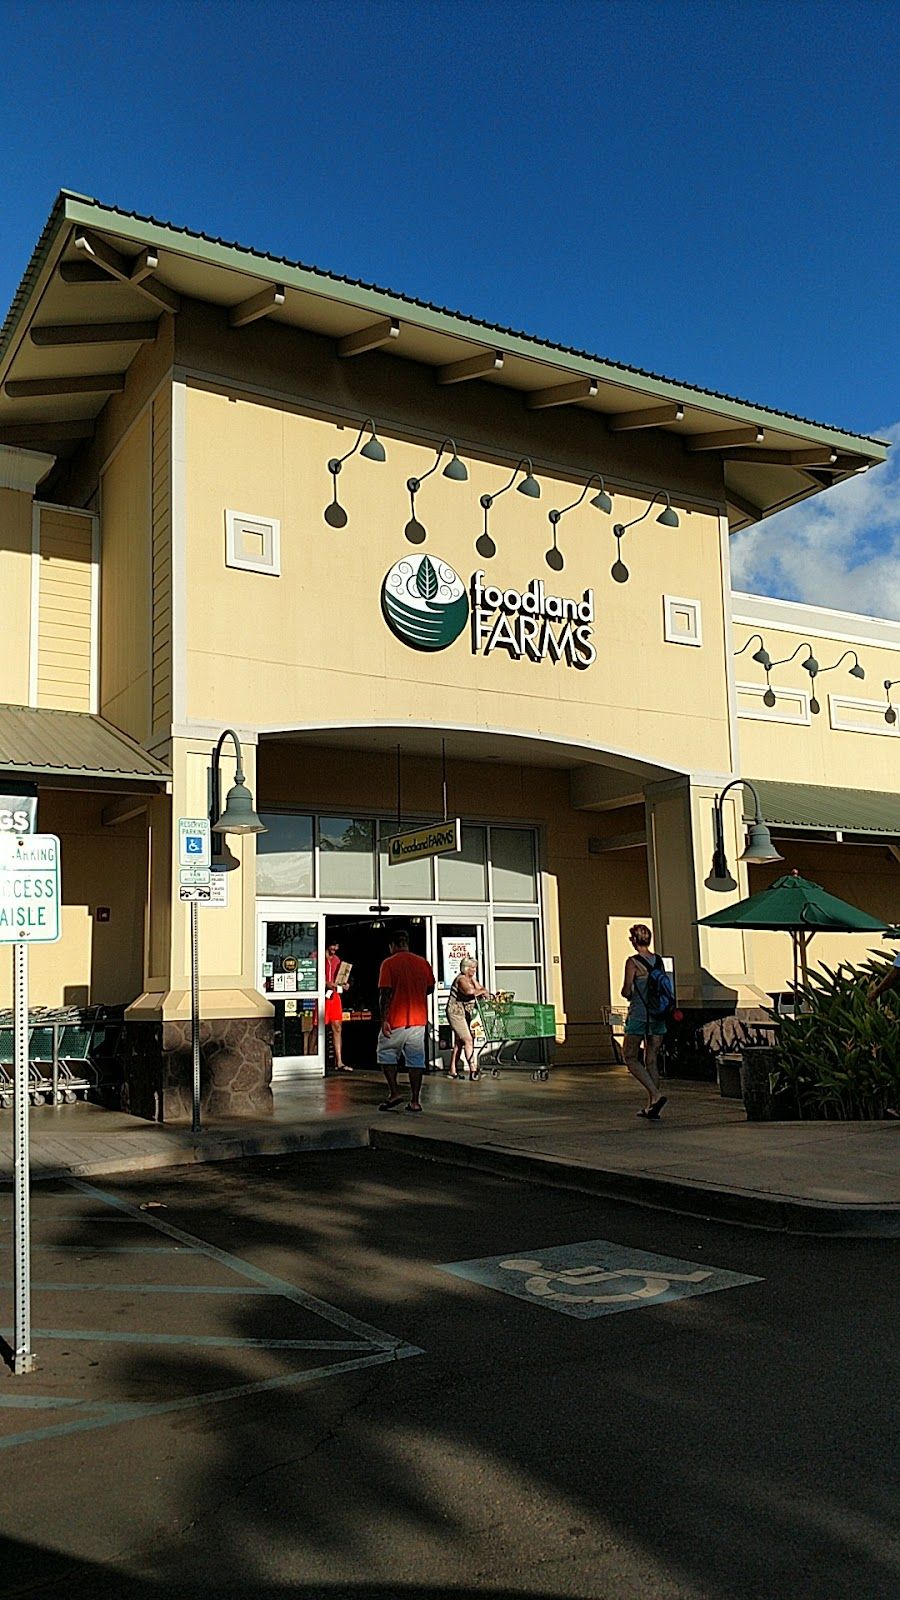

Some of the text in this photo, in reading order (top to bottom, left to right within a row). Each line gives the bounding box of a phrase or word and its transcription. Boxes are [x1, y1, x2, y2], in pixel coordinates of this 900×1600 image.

[474, 569, 595, 623] foodland
[474, 605, 598, 666] FARMS
[181, 821, 208, 829] RESERVED
[182, 828, 206, 836] PARKING
[401, 829, 454, 854] foodland FARMS
[11, 848, 54, 861] ARKING
[0, 906, 46, 926] AISLE
